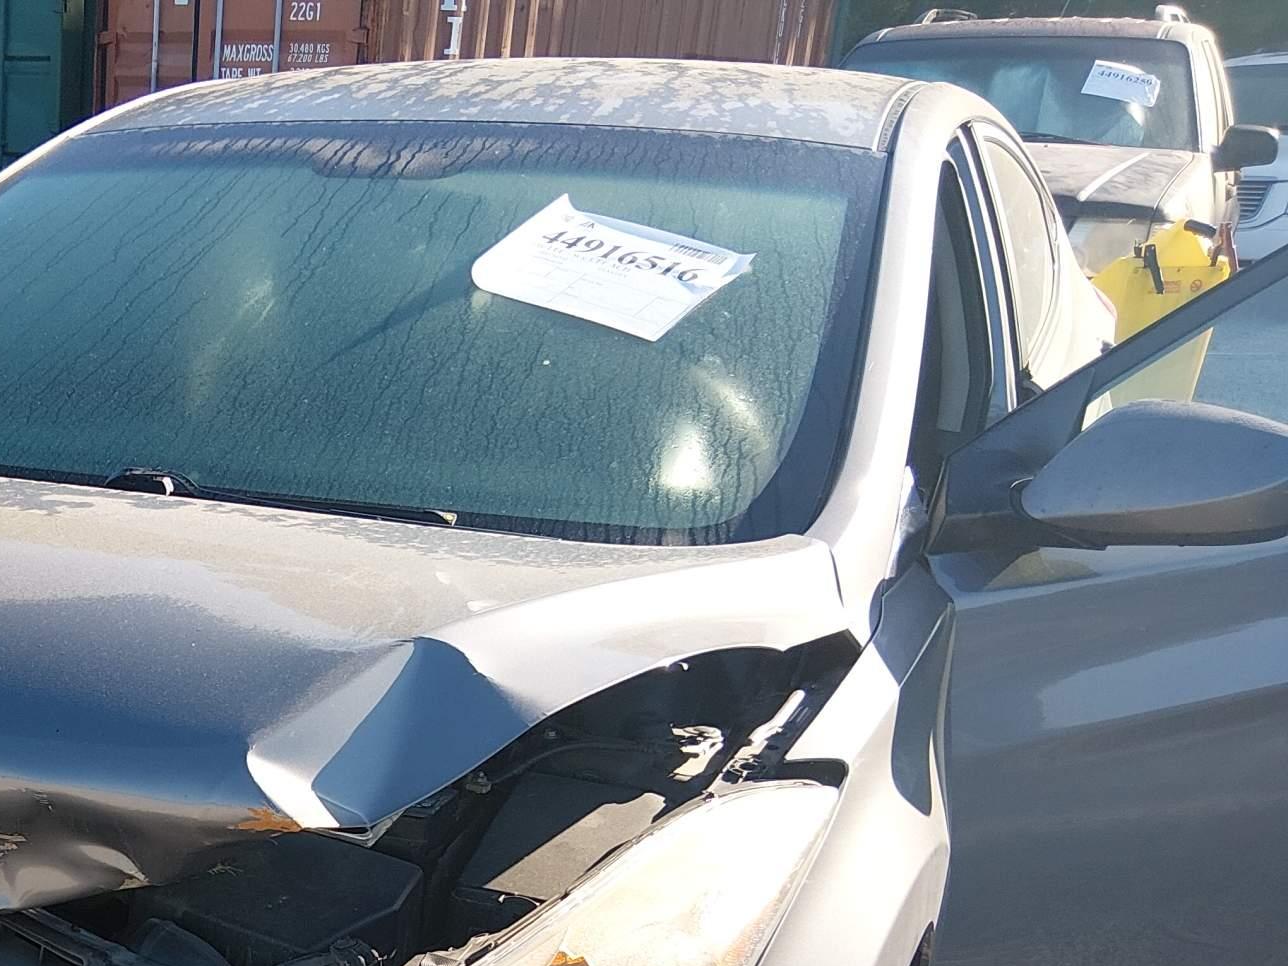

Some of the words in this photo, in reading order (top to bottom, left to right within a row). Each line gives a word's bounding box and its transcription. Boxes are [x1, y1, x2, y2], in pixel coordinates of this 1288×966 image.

[289, 2, 321, 21] 22G1
[222, 43, 274, 63] MAXGROSS
[314, 53, 329, 63] LBS
[316, 43, 330, 54] KGS
[541, 230, 705, 283] 44916516
